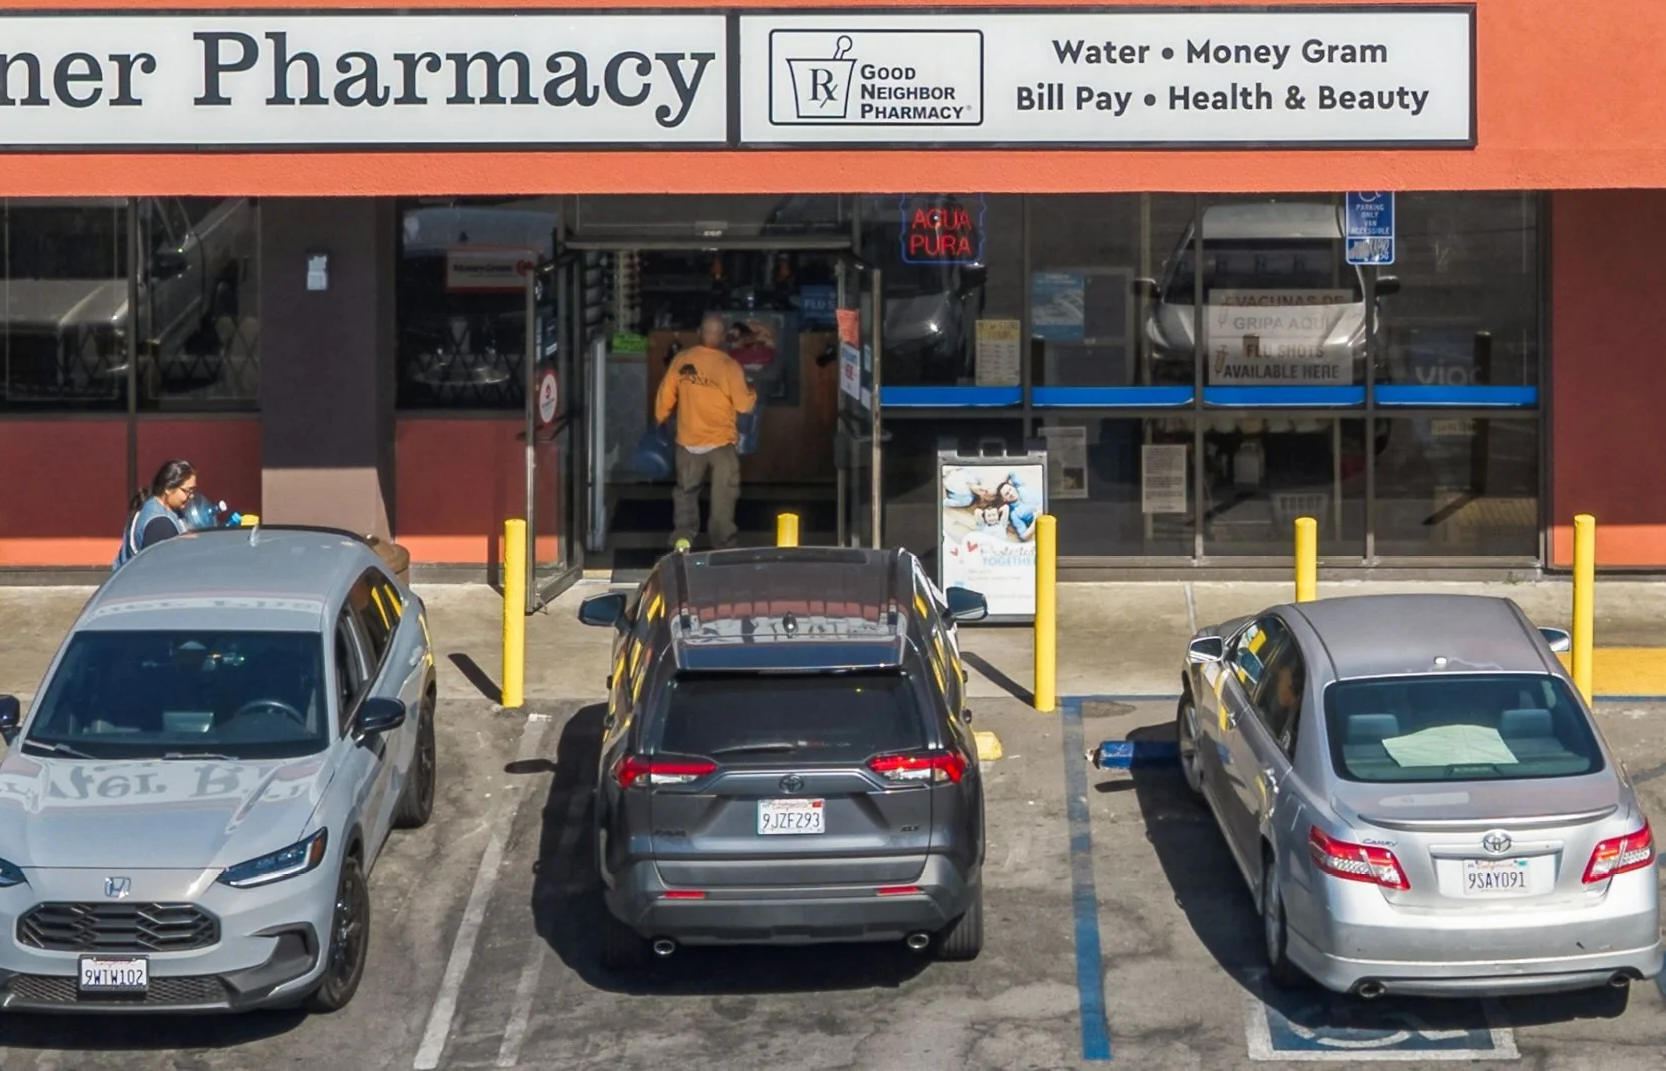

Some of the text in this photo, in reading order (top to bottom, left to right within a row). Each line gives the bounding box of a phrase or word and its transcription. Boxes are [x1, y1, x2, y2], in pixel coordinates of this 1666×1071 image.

[1052, 38, 1388, 70] Water Money Gram
[192, 31, 716, 128] Pharmacy
[860, 63, 916, 80] GOOD
[860, 83, 955, 100] NEIGHBOR
[1017, 82, 1430, 117] Bill Pay Health & Beauty
[912, 208, 973, 230] AGUA
[910, 234, 972, 257] PURA
[1234, 295, 1316, 307] VACUNAS
[1234, 316, 1285, 330] GRIPA
[1246, 344, 1325, 358] FLU SHOTS
[1223, 364, 1340, 379] AVAILABLE HERE
[1468, 871, 1527, 889] 9SAY091
